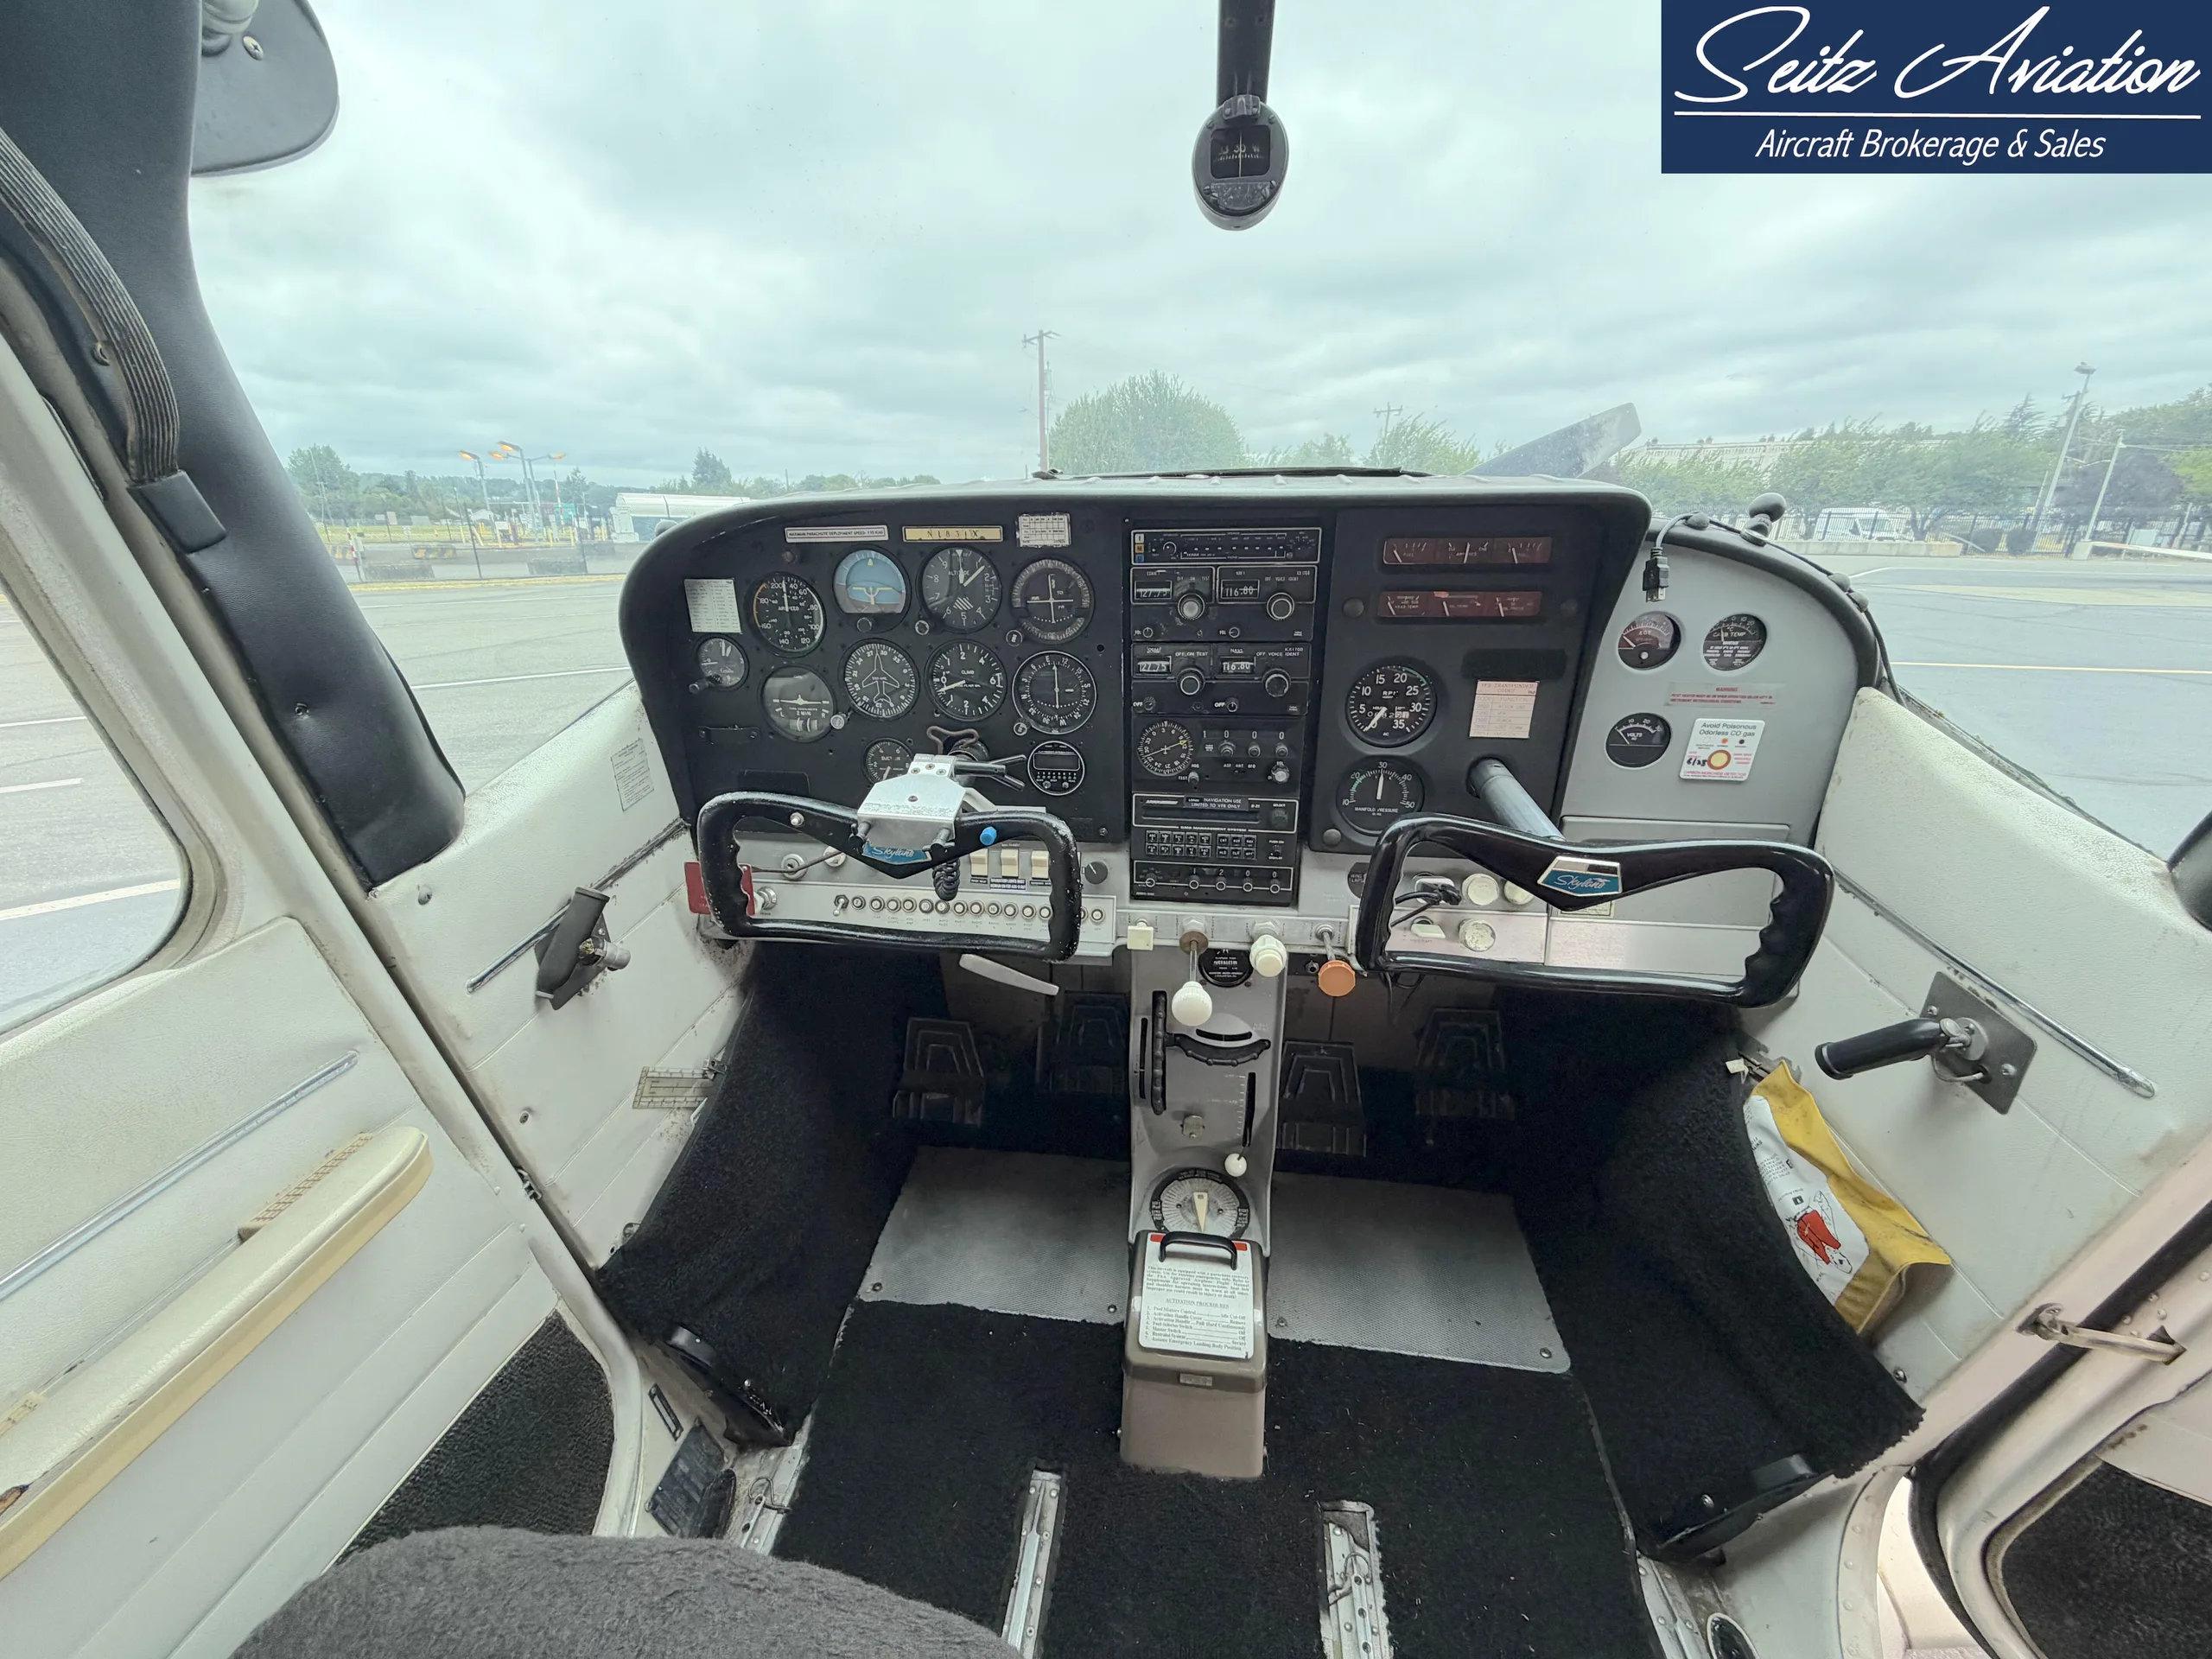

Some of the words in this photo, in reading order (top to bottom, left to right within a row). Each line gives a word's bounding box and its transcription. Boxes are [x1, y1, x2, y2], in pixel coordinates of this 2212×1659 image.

[984, 573, 990, 582] 2
[1376, 674, 1385, 684] 15
[1394, 673, 1408, 683] 20
[1362, 686, 1371, 696] 10
[1406, 685, 1419, 696] 25
[1359, 703, 1366, 714] 5
[1409, 702, 1422, 713] 30
[1392, 719, 1405, 729] 35
[1224, 730, 1230, 739] 0
[1252, 730, 1257, 739] 0
[1279, 731, 1284, 740] 0
[1554, 874, 1607, 890] Skylane
